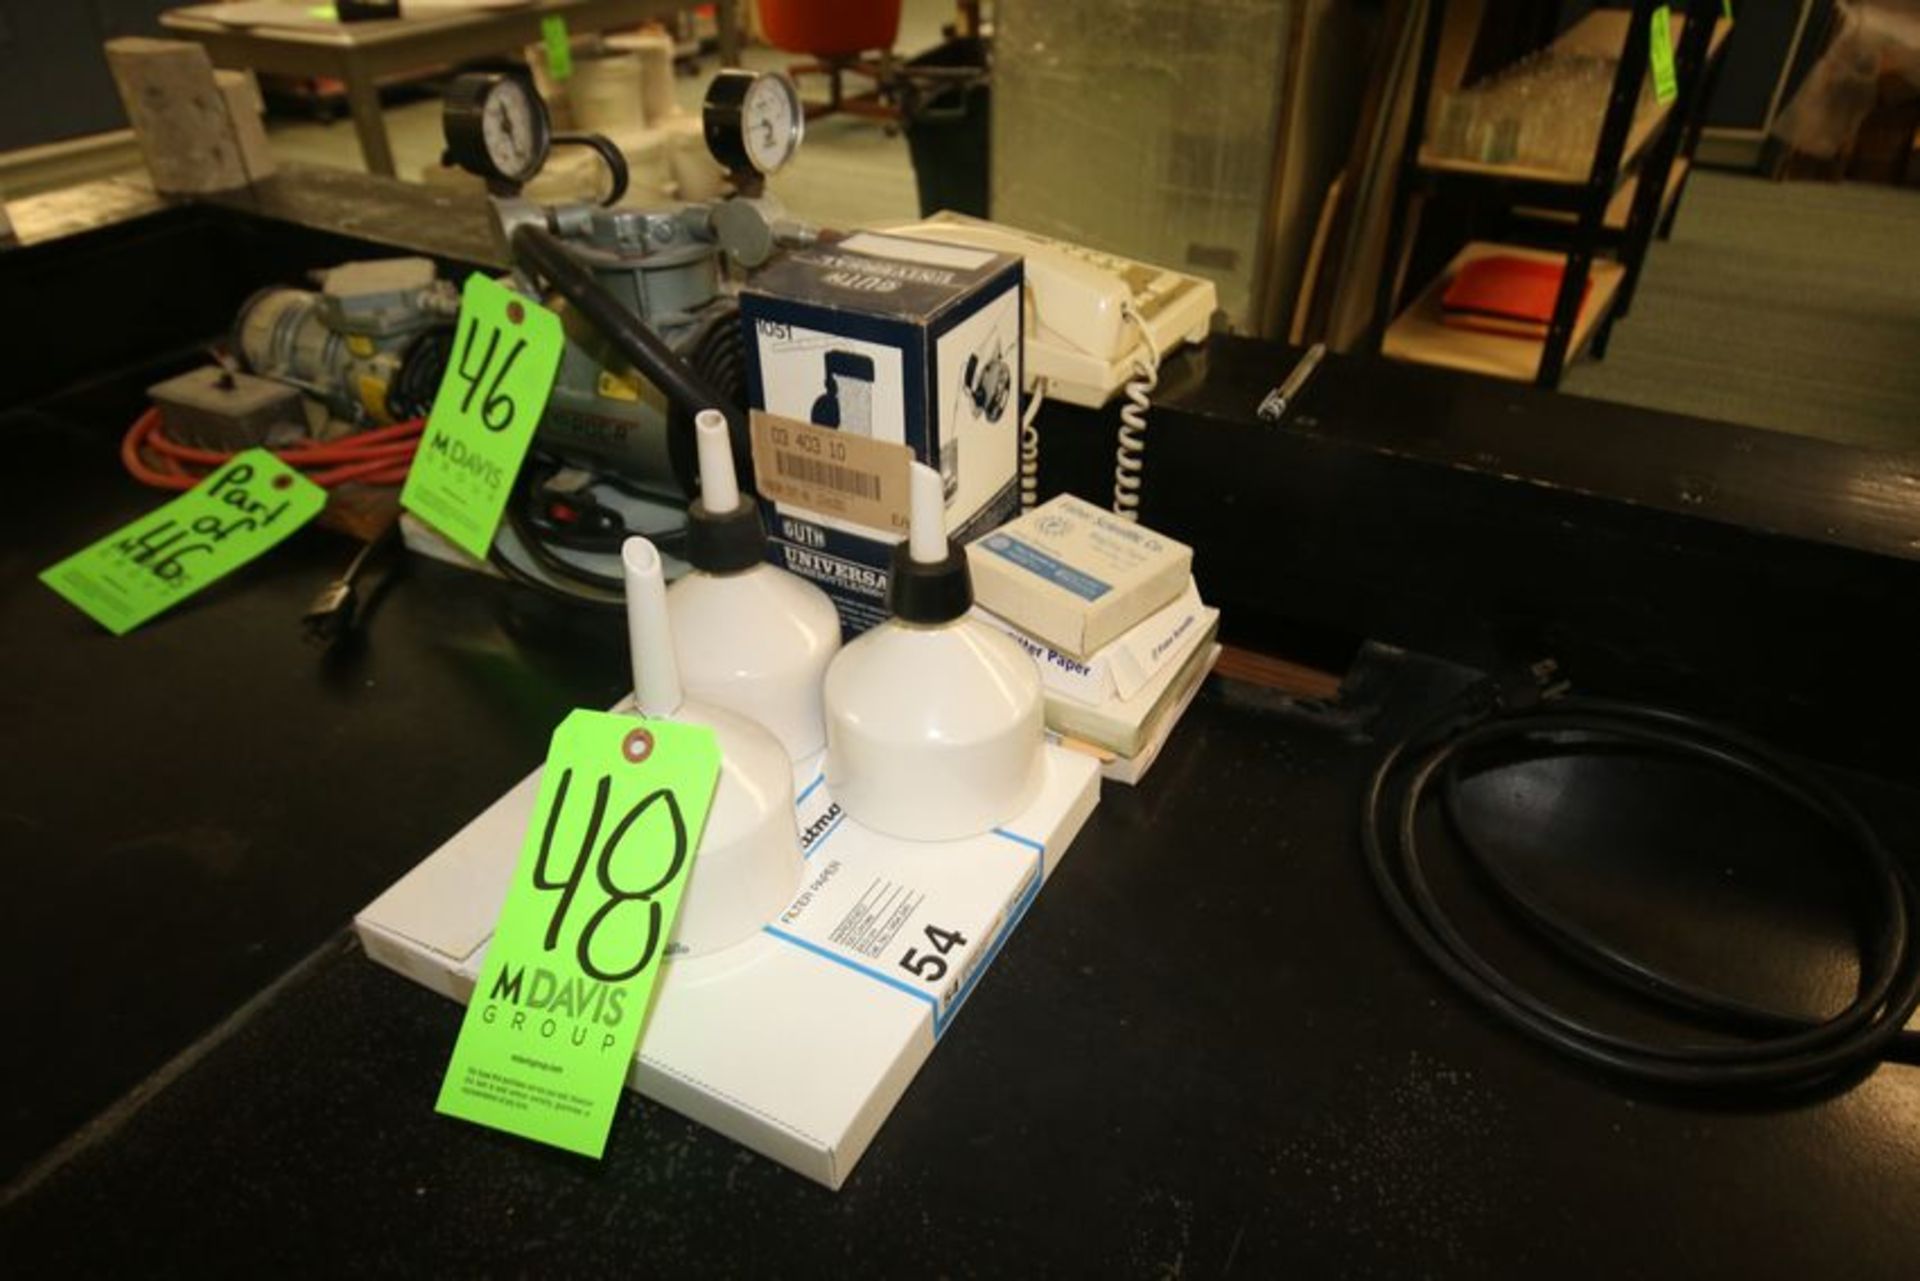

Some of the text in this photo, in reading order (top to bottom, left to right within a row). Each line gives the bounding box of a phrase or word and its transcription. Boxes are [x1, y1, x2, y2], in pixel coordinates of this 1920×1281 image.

[459, 317, 527, 432] 46
[208, 464, 291, 527] Part
[132, 520, 214, 580] 46
[192, 515, 258, 542] of
[783, 519, 826, 547] GUTH
[1047, 649, 1091, 677] Paper
[533, 767, 688, 982] 48
[899, 924, 967, 982] 54
[482, 1004, 616, 1053] GROUP
